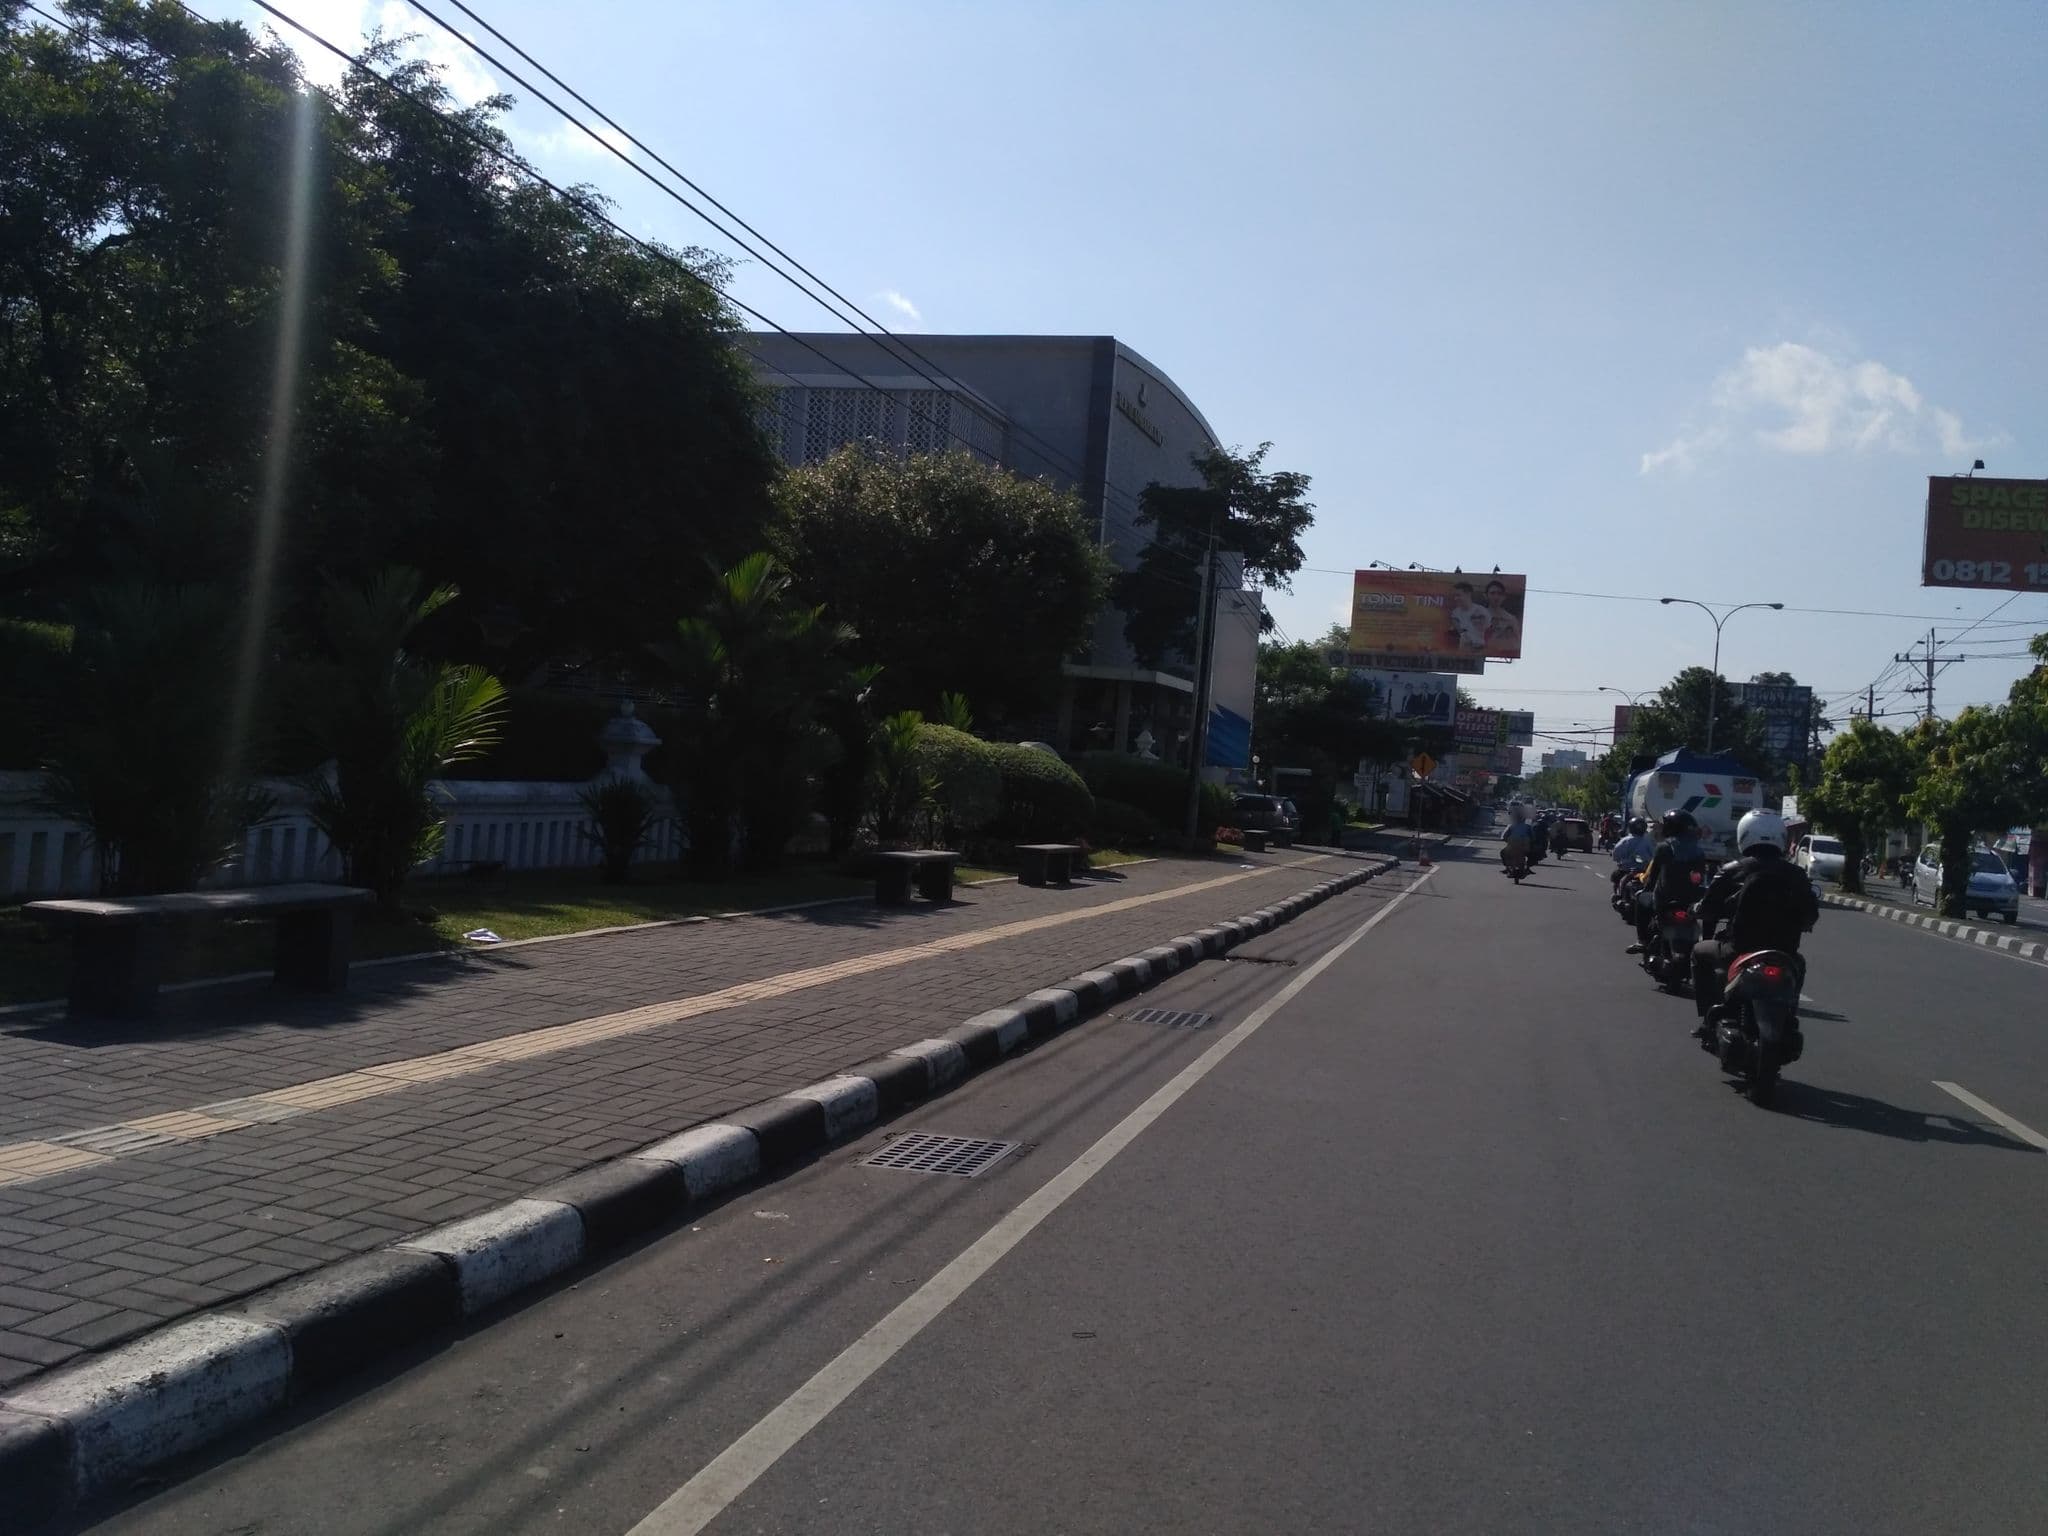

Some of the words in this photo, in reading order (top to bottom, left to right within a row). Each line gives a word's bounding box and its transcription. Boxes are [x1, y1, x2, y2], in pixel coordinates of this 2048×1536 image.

[1952, 485, 2046, 508] SPACE
[1932, 559, 2011, 583] 0812
[1414, 595, 1445, 607] TINI
[1456, 711, 1497, 724] OPTIK
